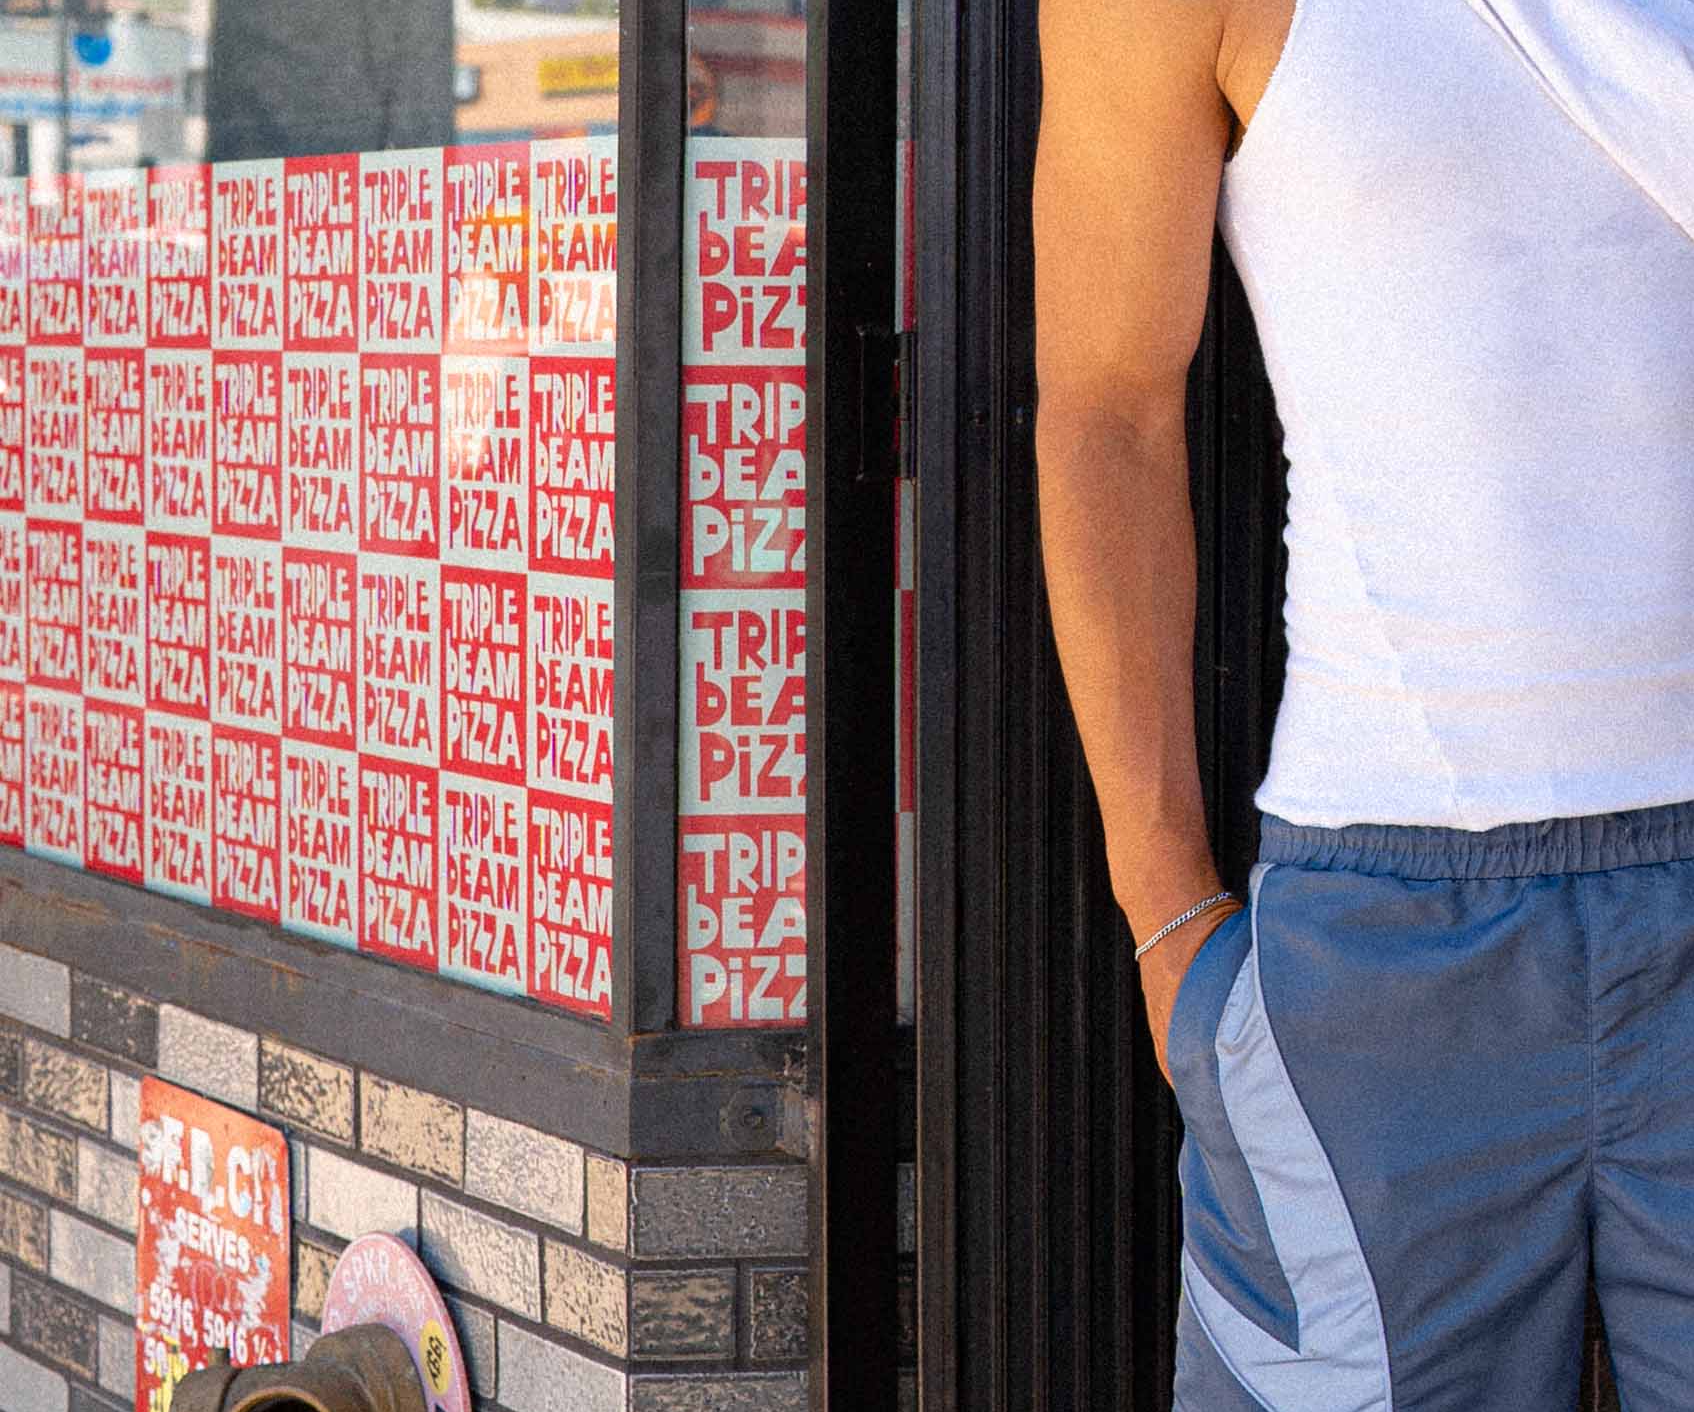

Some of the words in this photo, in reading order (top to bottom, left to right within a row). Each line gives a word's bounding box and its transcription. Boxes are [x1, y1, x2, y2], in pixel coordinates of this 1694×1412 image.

[289, 169, 351, 226] TRIPLE
[444, 579, 518, 646] TRIPLE
[175, 1206, 250, 1273] SERVES
[203, 1308, 248, 1364] 5916
